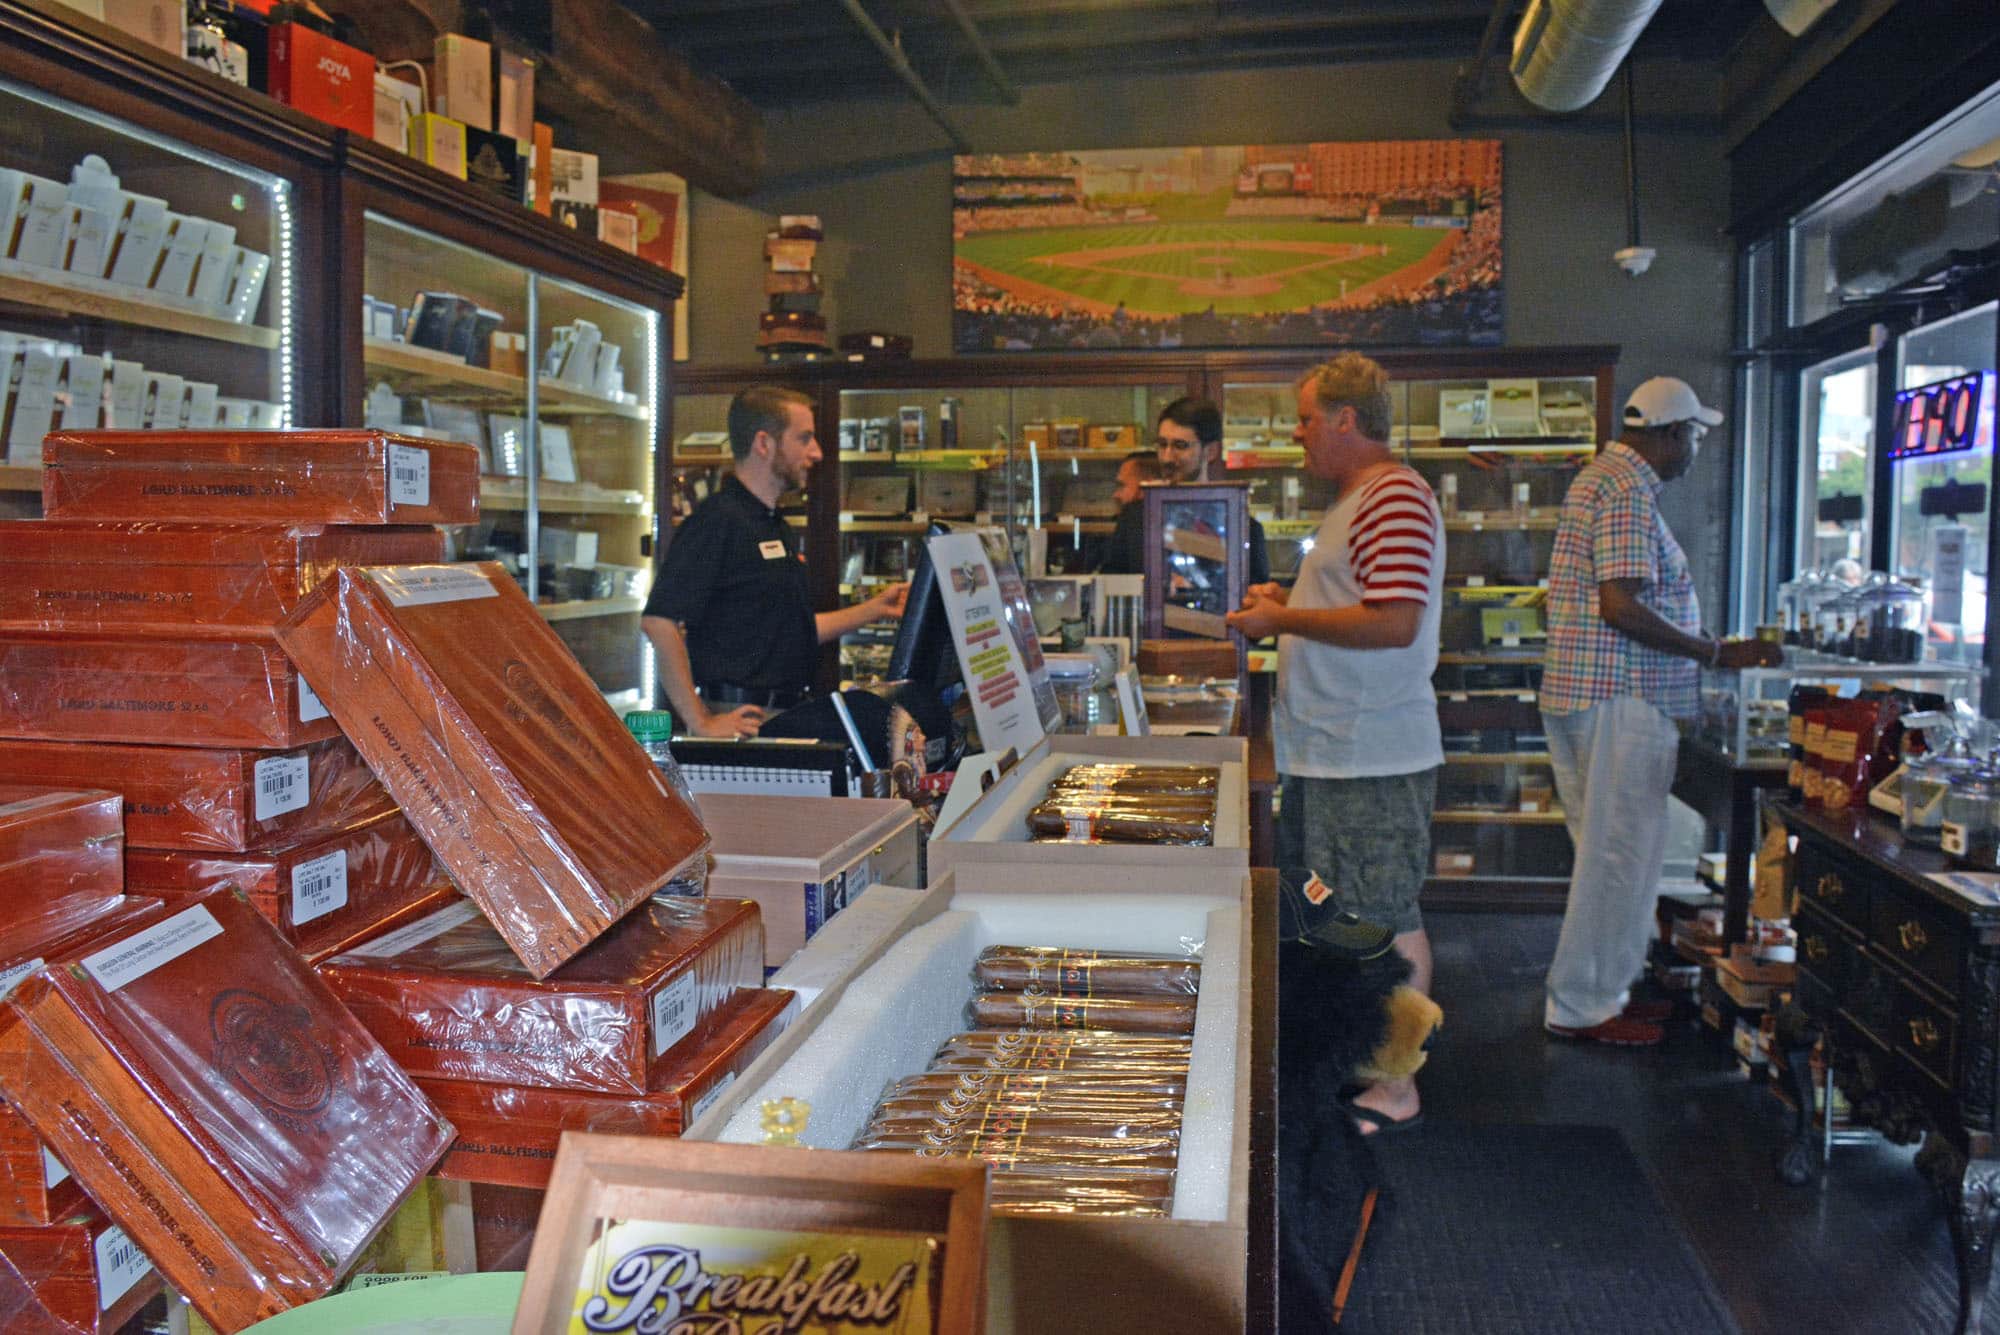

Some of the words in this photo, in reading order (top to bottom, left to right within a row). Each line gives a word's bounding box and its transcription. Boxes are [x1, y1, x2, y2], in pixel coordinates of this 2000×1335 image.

[316, 57, 352, 81] JOYA
[142, 484, 177, 497] LORD
[180, 484, 256, 497] BALTIMORE
[76, 590, 149, 602] BALTIMORE
[59, 698, 97, 711] LORD
[100, 699, 177, 713] BALTIMORE
[373, 716, 401, 752] LORD
[400, 753, 457, 824] BALTIMORE
[450, 1141, 486, 1154] LORD
[101, 1142, 179, 1231] BALTIMORE
[583, 1244, 917, 1334] Breakfast
